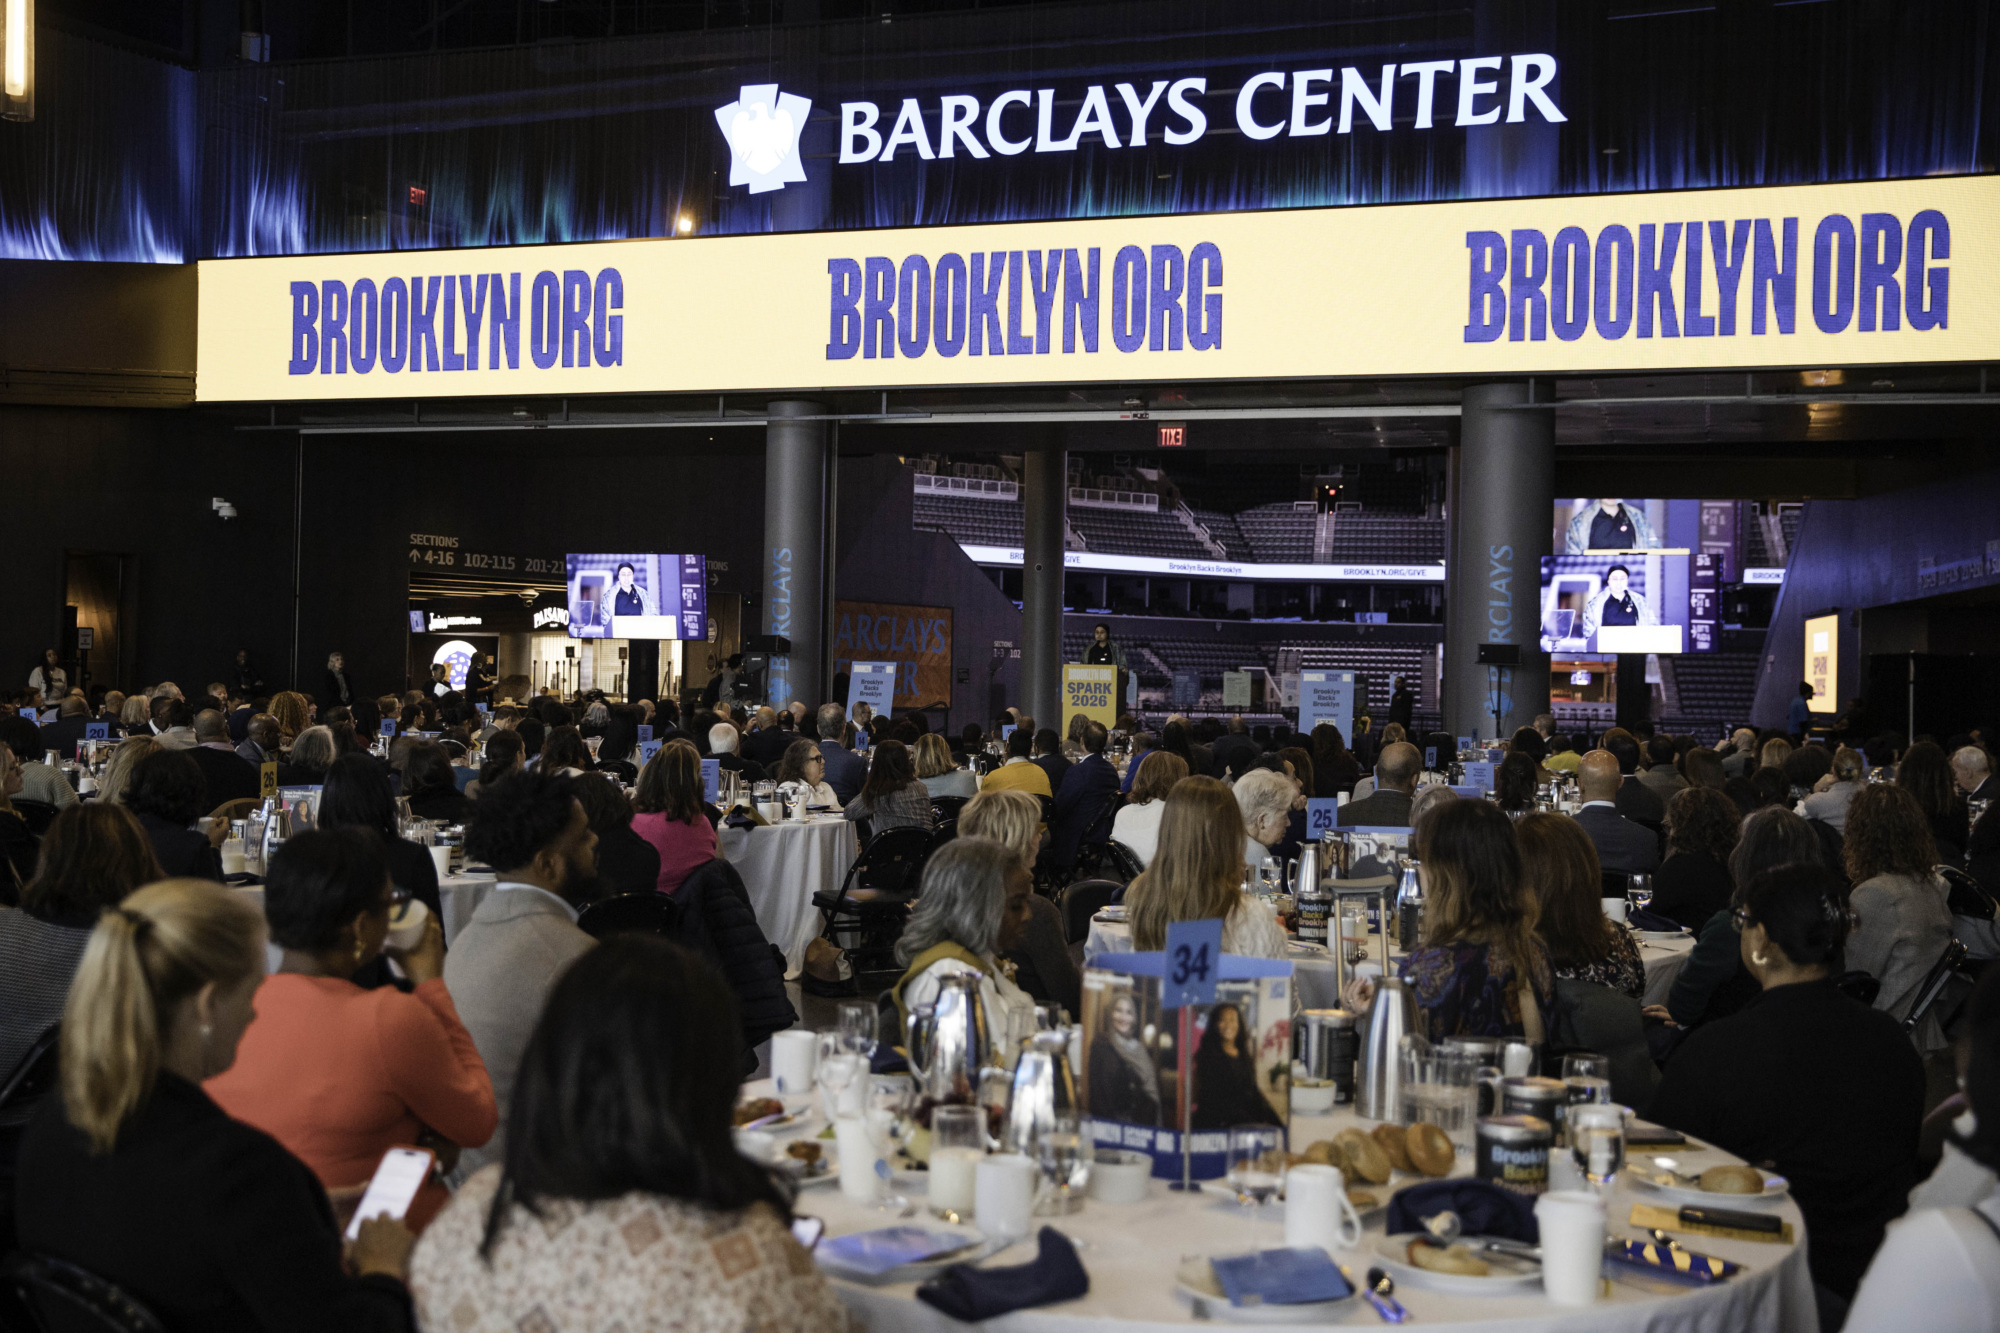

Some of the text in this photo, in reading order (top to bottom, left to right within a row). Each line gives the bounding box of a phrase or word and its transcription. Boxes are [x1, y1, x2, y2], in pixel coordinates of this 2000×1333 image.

[839, 53, 1567, 163] BARCLAYS CENTER
[410, 187, 425, 205] EXIT
[1464, 209, 1950, 343] BROOKLYN ORG
[827, 242, 1222, 359] BROOKLYN ORG
[290, 268, 624, 375] BROOKLYN ORG
[410, 534, 459, 548] SECTIONS
[424, 550, 567, 574] 4-16 102-115 201-21
[706, 560, 729, 571] TIONS
[1169, 562, 1242, 576] Brooklyn Backs Brooklyn
[1343, 568, 1427, 577] BROOKLYN.ORG/GIVE
[771, 547, 792, 671] BRCLAYS
[1488, 545, 1513, 683] BRCLAYS
[834, 613, 946, 653] ARCLAYS
[1067, 682, 1112, 694] SPARK
[1072, 694, 1108, 707] 2026
[89, 728, 105, 739] 20
[384, 723, 393, 732] 15
[858, 736, 867, 745] 14
[263, 771, 275, 788] 26
[1313, 808, 1333, 829] 25
[1299, 902, 1329, 912] Brooklyn
[1299, 917, 1329, 928] Brooklyn
[1302, 911, 1324, 919] Backs
[1172, 942, 1210, 985] 34
